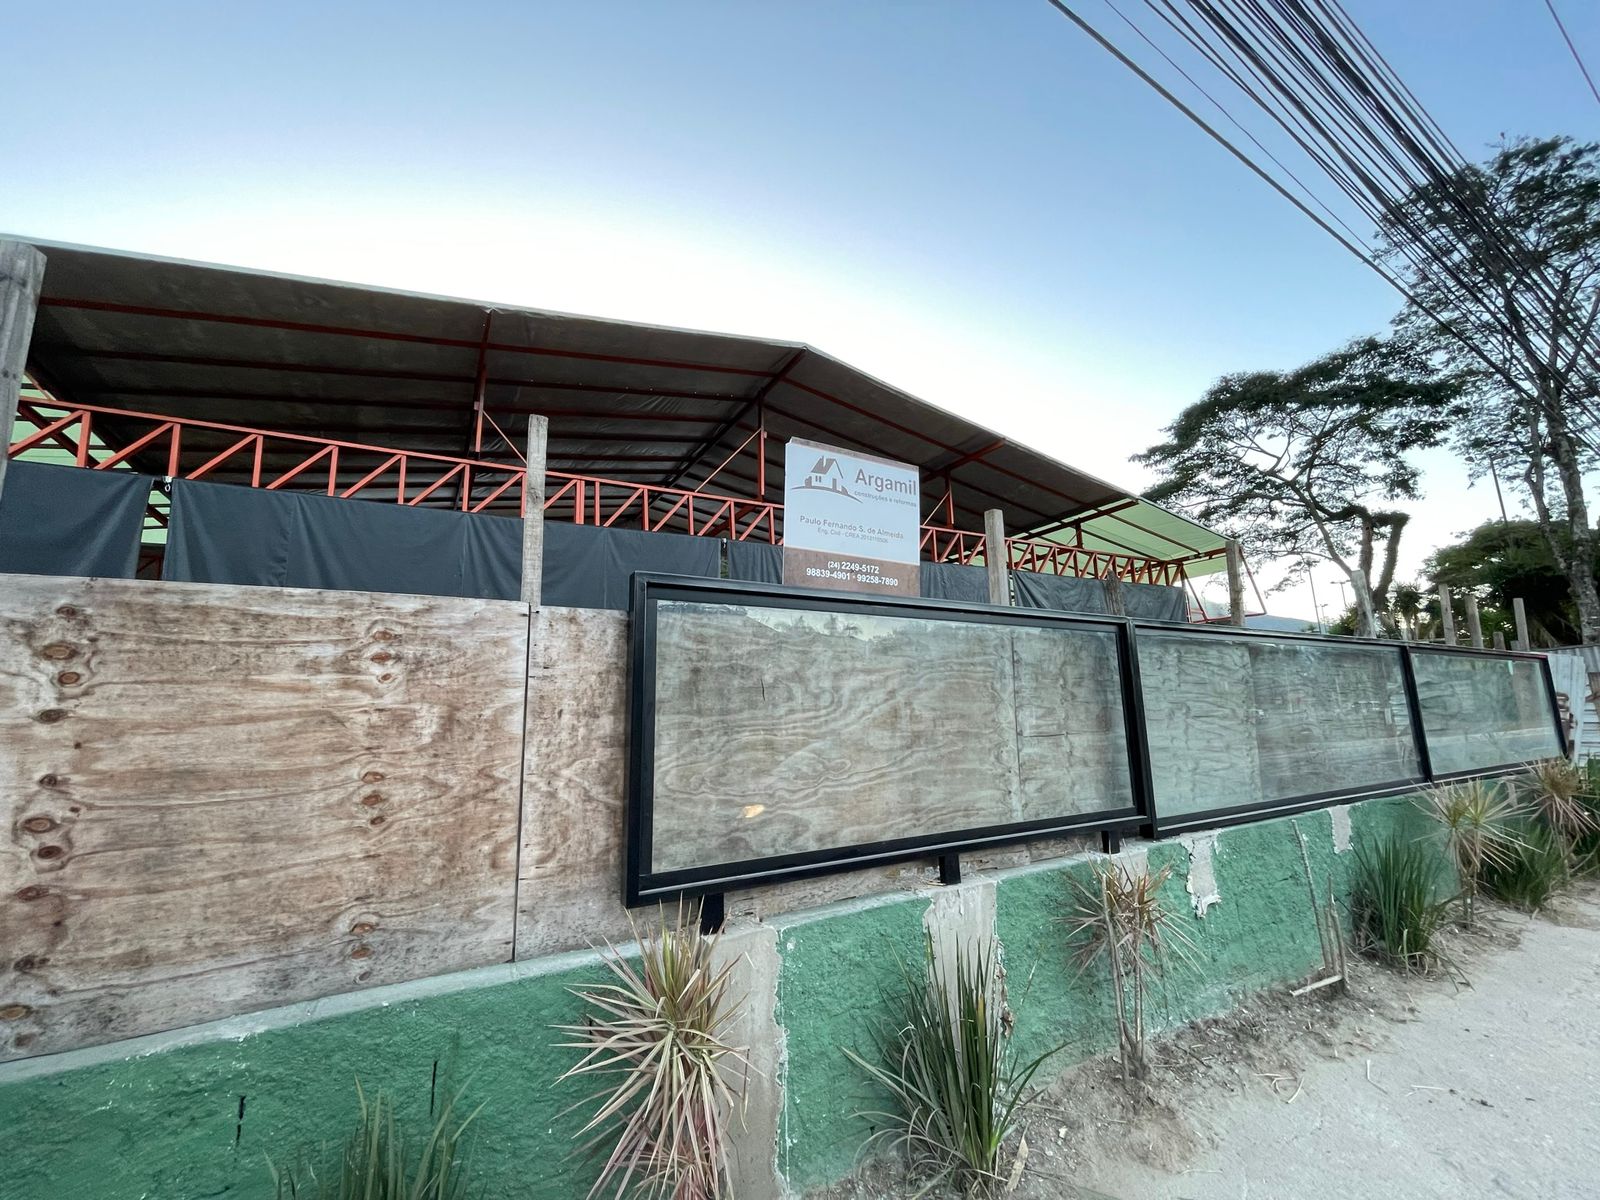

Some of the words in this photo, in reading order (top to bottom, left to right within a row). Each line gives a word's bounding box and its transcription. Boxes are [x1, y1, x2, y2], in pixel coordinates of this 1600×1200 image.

[855, 468, 916, 496] Argamil
[800, 515, 821, 526] Paulo
[823, 519, 857, 531] Fernando
[867, 527, 876, 535] de
[877, 528, 904, 539] Almeida
[806, 567, 850, 580] 98839-4901
[856, 574, 898, 586] 99258-7890
[827, 561, 840, 570] (24)
[841, 562, 879, 574] 2249-5172
